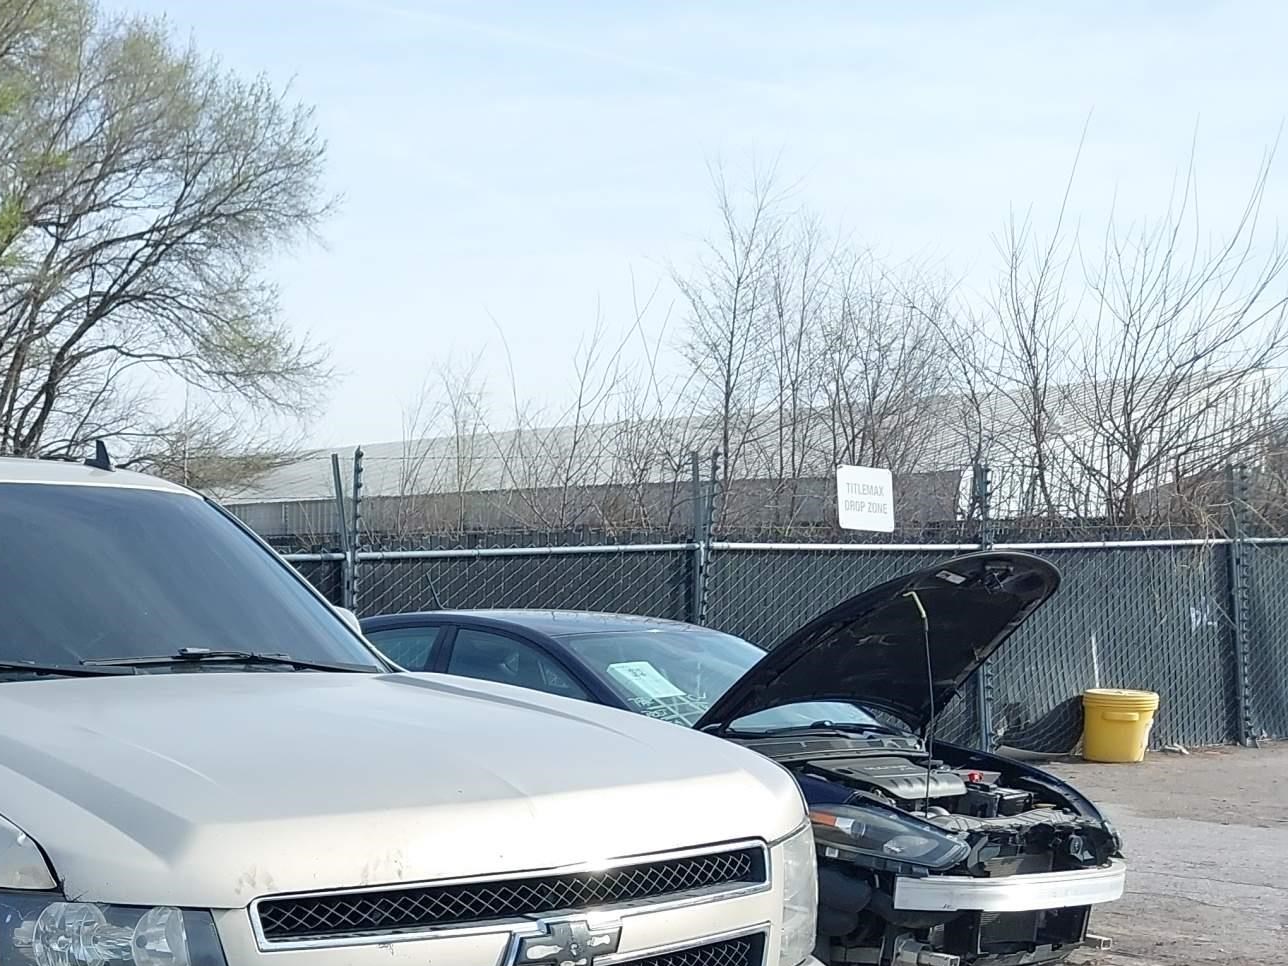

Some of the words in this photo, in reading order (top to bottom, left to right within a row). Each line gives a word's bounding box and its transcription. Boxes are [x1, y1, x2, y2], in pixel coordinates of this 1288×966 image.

[846, 482, 884, 496] TITLEMAX
[844, 500, 865, 512] DROP
[868, 502, 887, 514] ZONE
